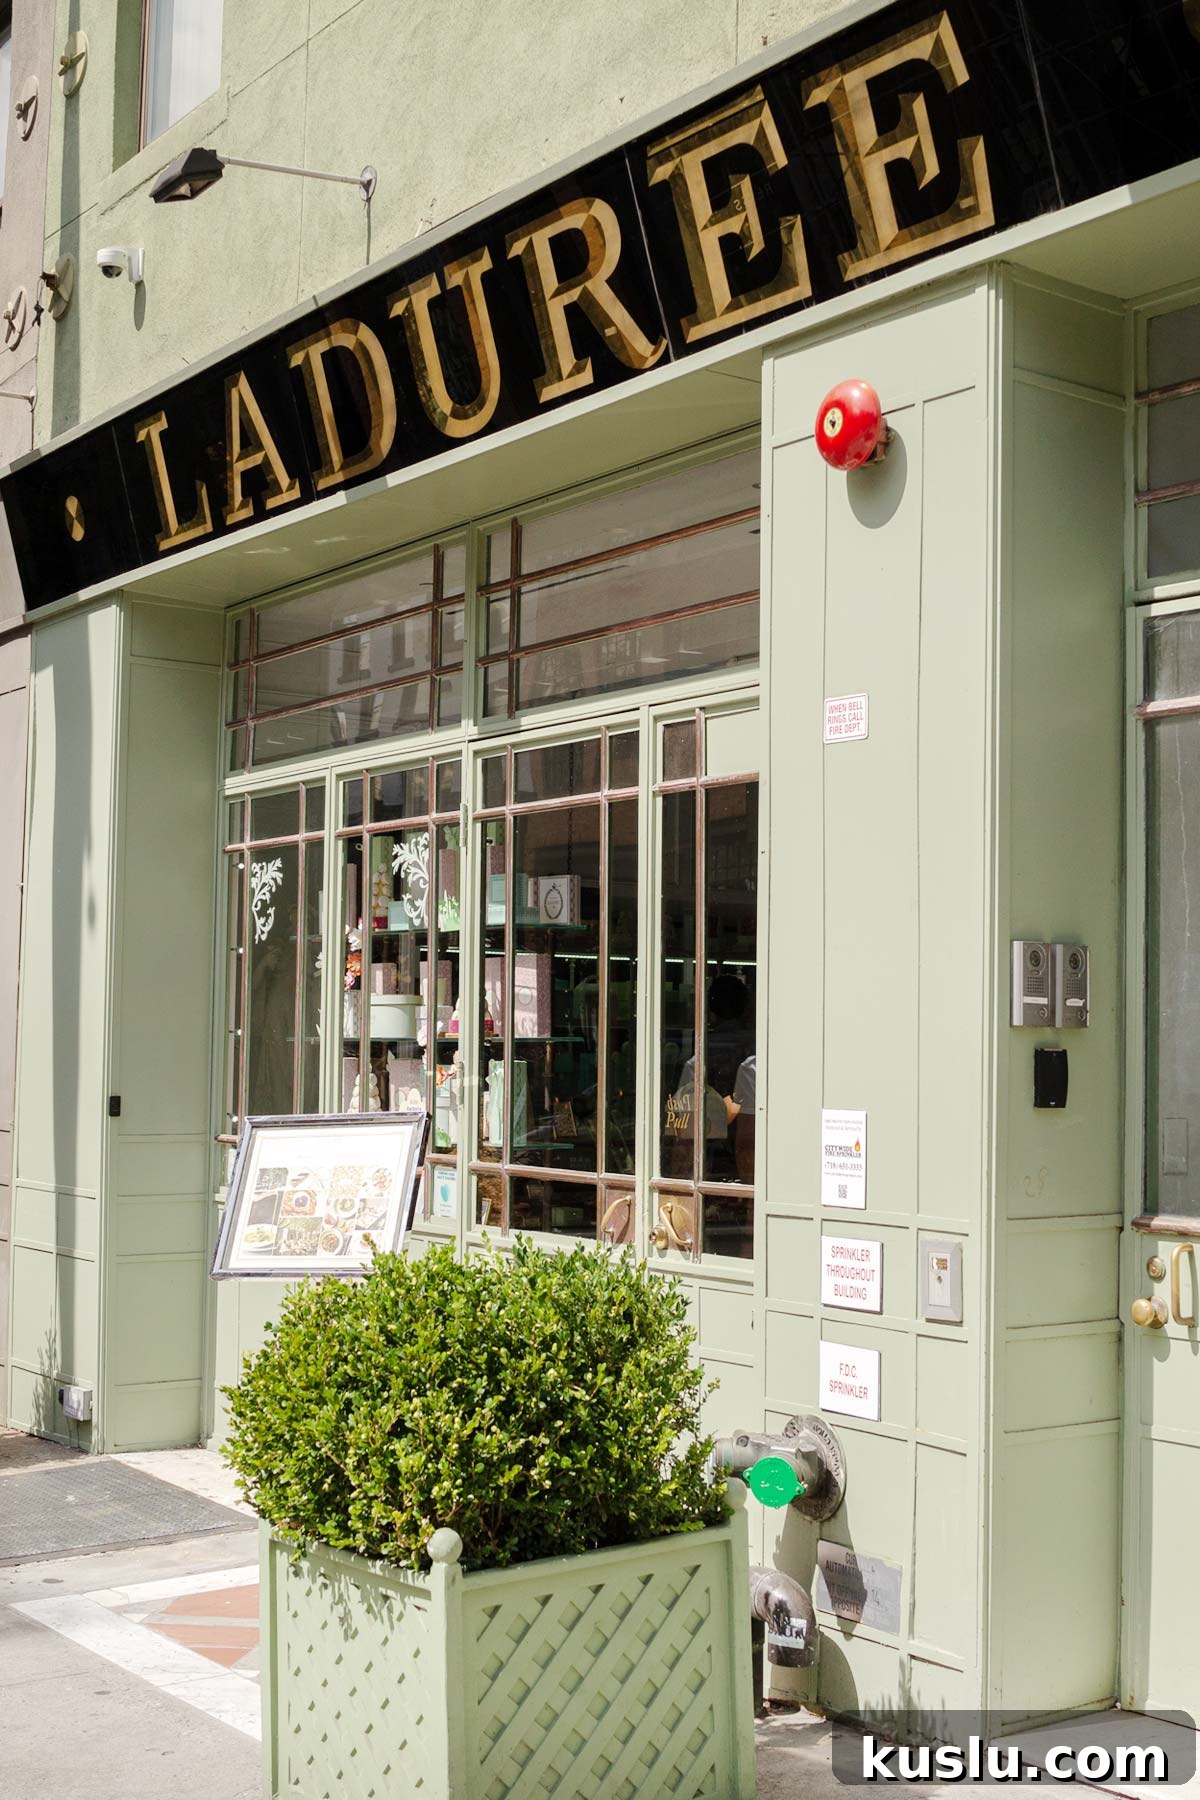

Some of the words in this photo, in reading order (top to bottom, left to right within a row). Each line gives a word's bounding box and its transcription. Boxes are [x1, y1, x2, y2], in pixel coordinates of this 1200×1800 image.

[828, 703, 847, 714] WHEN
[848, 700, 863, 711] BELL
[828, 714, 847, 725] RINGS
[848, 711, 864, 722] CALL
[829, 725, 843, 735] FIRE
[665, 1111, 690, 1135] Pull
[831, 1245, 870, 1262] SPRINKLER
[826, 1263, 875, 1282] THROUGHOUT
[833, 1283, 868, 1301] BUILDING
[839, 1362, 858, 1379] F.D.C.
[829, 1379, 869, 1400] SPRINKLER
